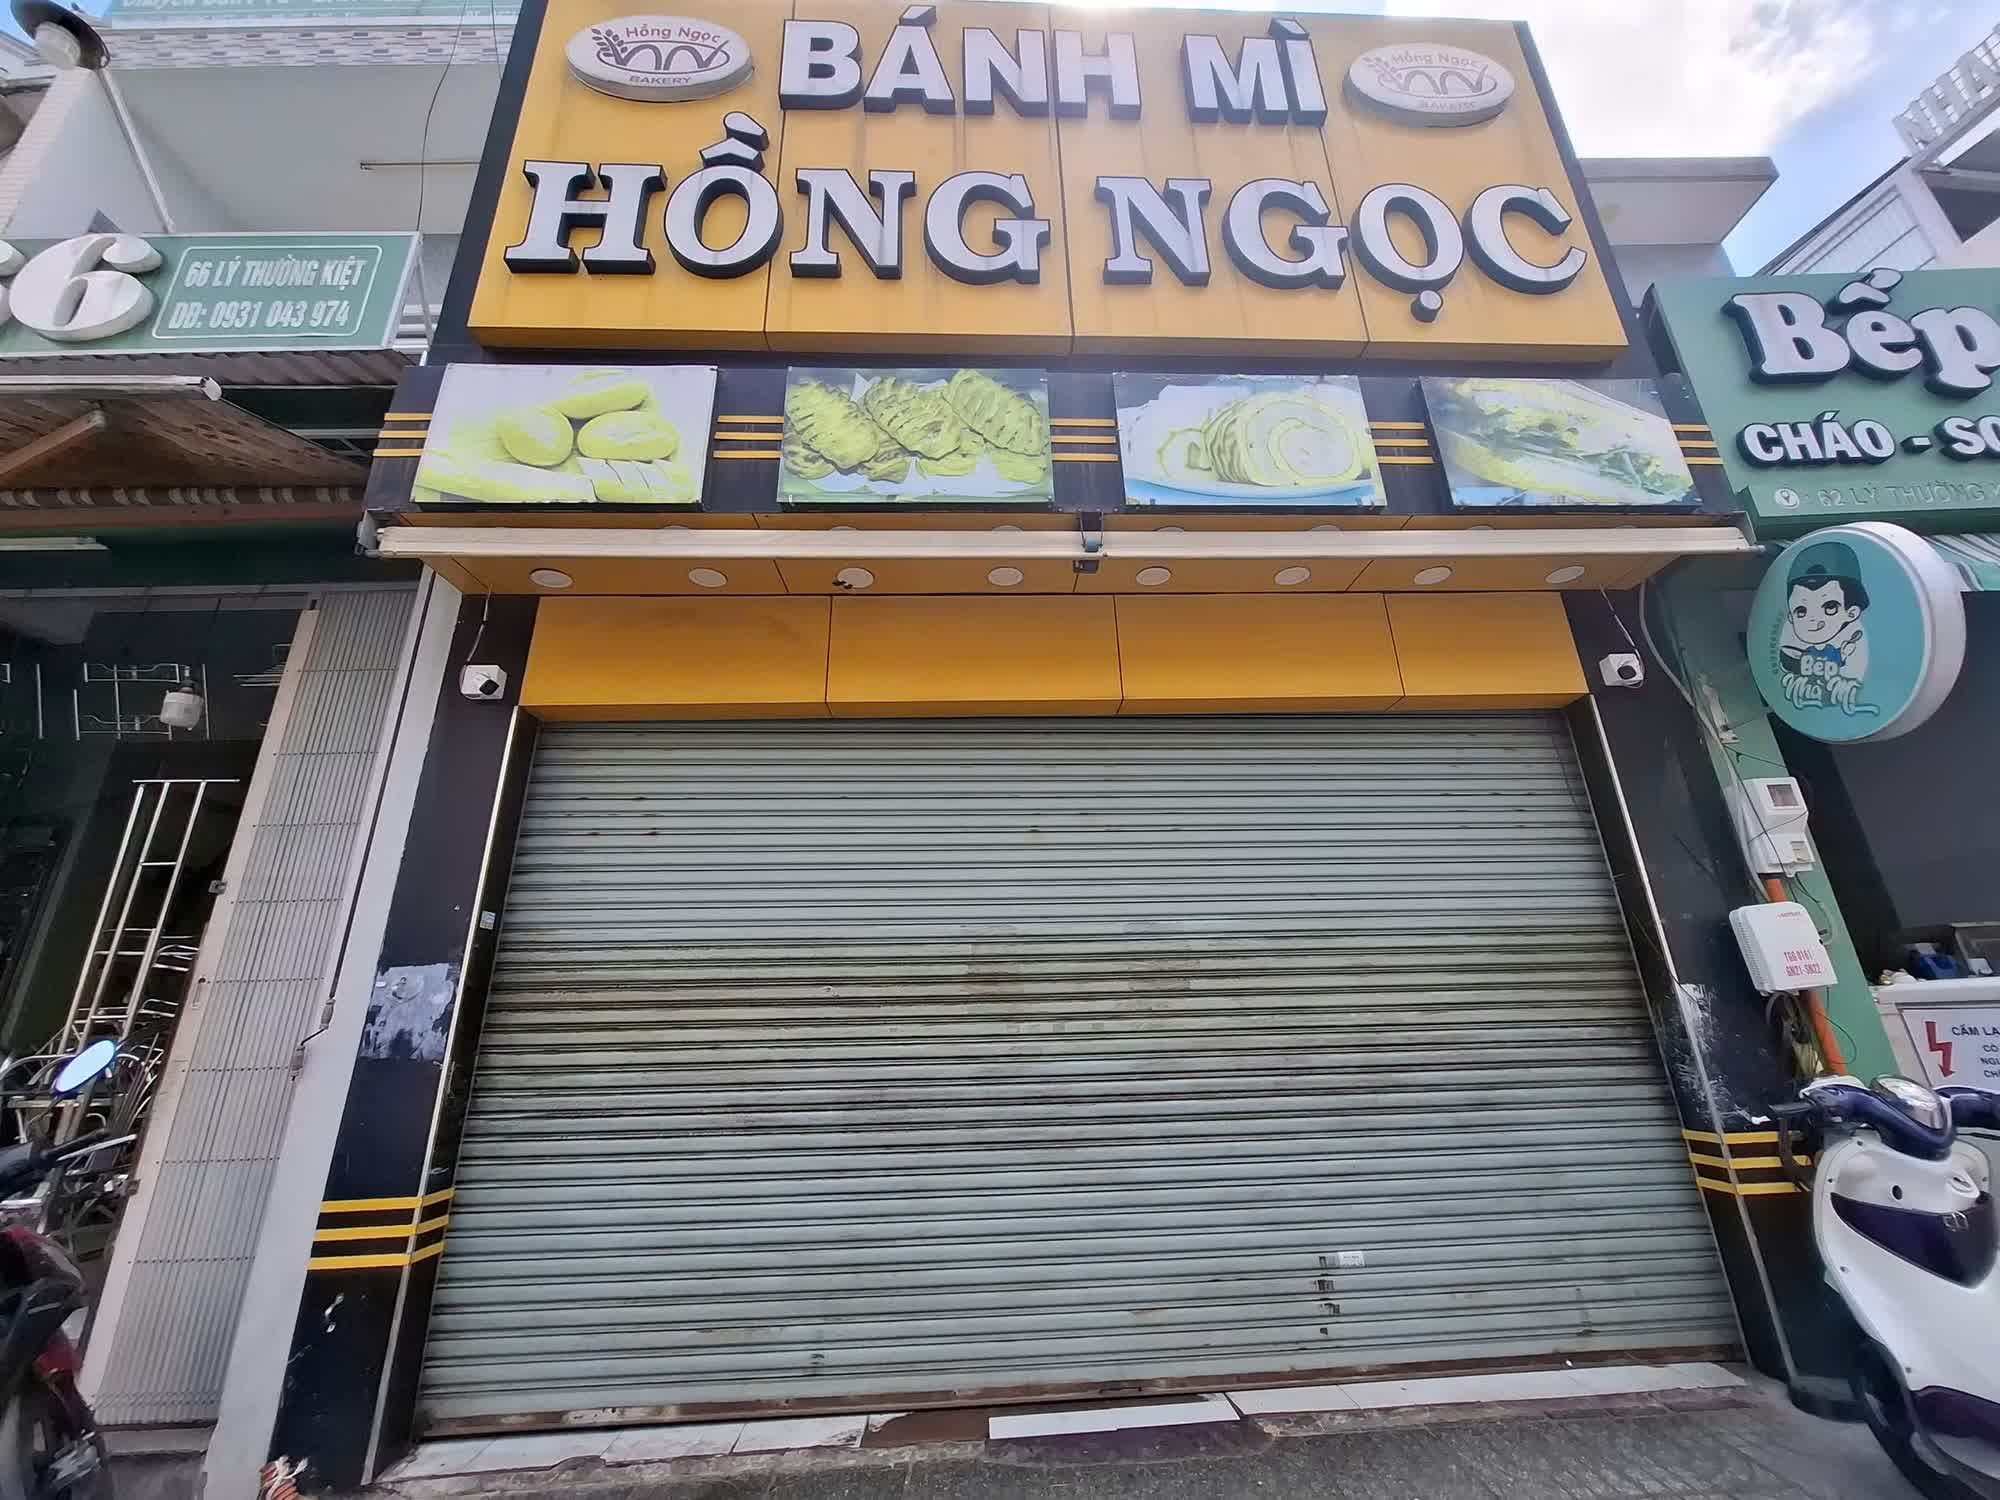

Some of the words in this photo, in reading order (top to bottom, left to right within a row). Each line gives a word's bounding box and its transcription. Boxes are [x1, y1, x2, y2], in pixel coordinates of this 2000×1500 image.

[626, 23, 671, 39] Hồng
[678, 26, 721, 43] Ngọc
[629, 75, 692, 85] BAKERY
[779, 4, 1141, 119] BÁNH
[1180, 16, 1328, 128] MÌ
[503, 111, 1051, 285] HỒNG
[1094, 176, 1588, 323] NGỌC
[184, 260, 213, 287] 66
[212, 255, 241, 287] LÝ
[241, 253, 319, 287] THƯỜNG
[320, 255, 368, 291] KIỆT
[209, 301, 263, 329] 0931
[265, 300, 307, 328] 043
[309, 300, 351, 327] 974
[1723, 267, 2000, 399] Bếp
[1738, 410, 1896, 464] CHÁO
